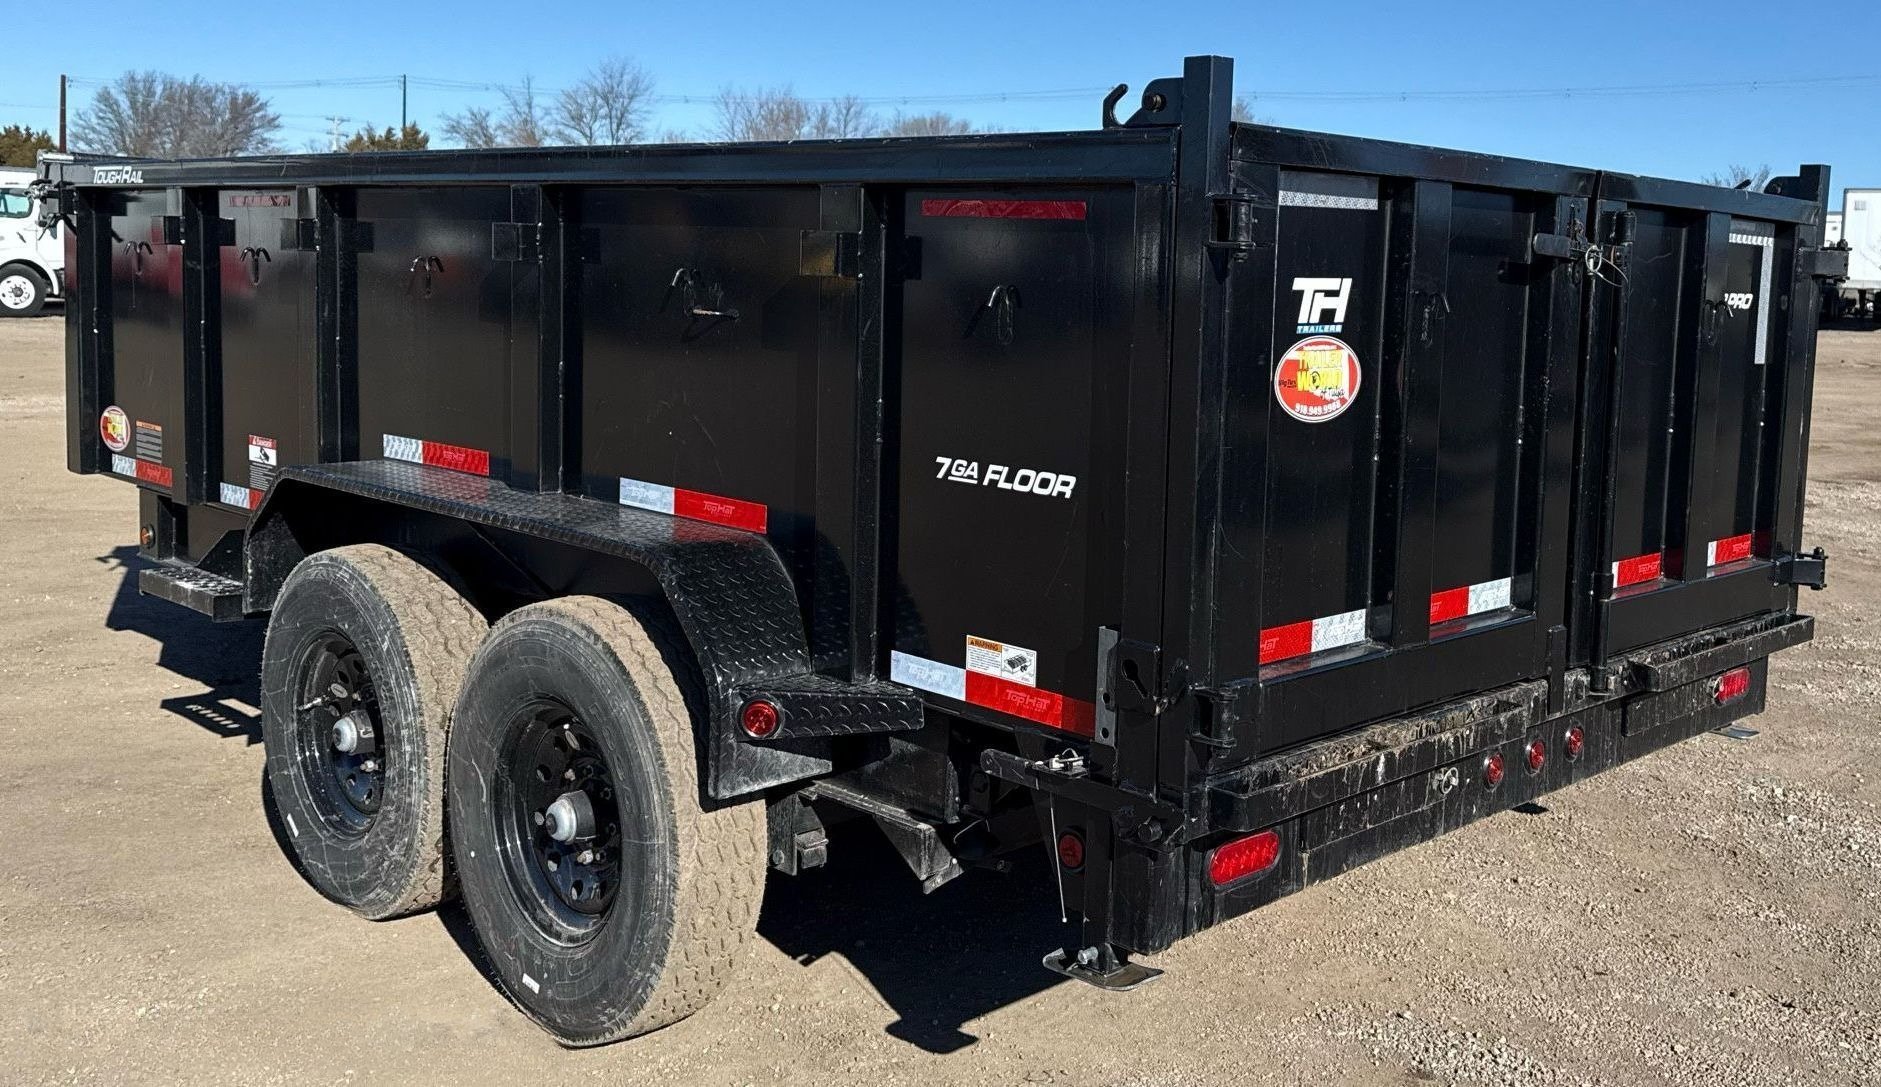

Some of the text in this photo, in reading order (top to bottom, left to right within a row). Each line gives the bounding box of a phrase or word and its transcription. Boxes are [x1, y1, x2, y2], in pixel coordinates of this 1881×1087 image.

[1292, 277, 1353, 324] TH
[1296, 324, 1343, 335] TRAILERS
[982, 464, 1077, 499] FLOOR
